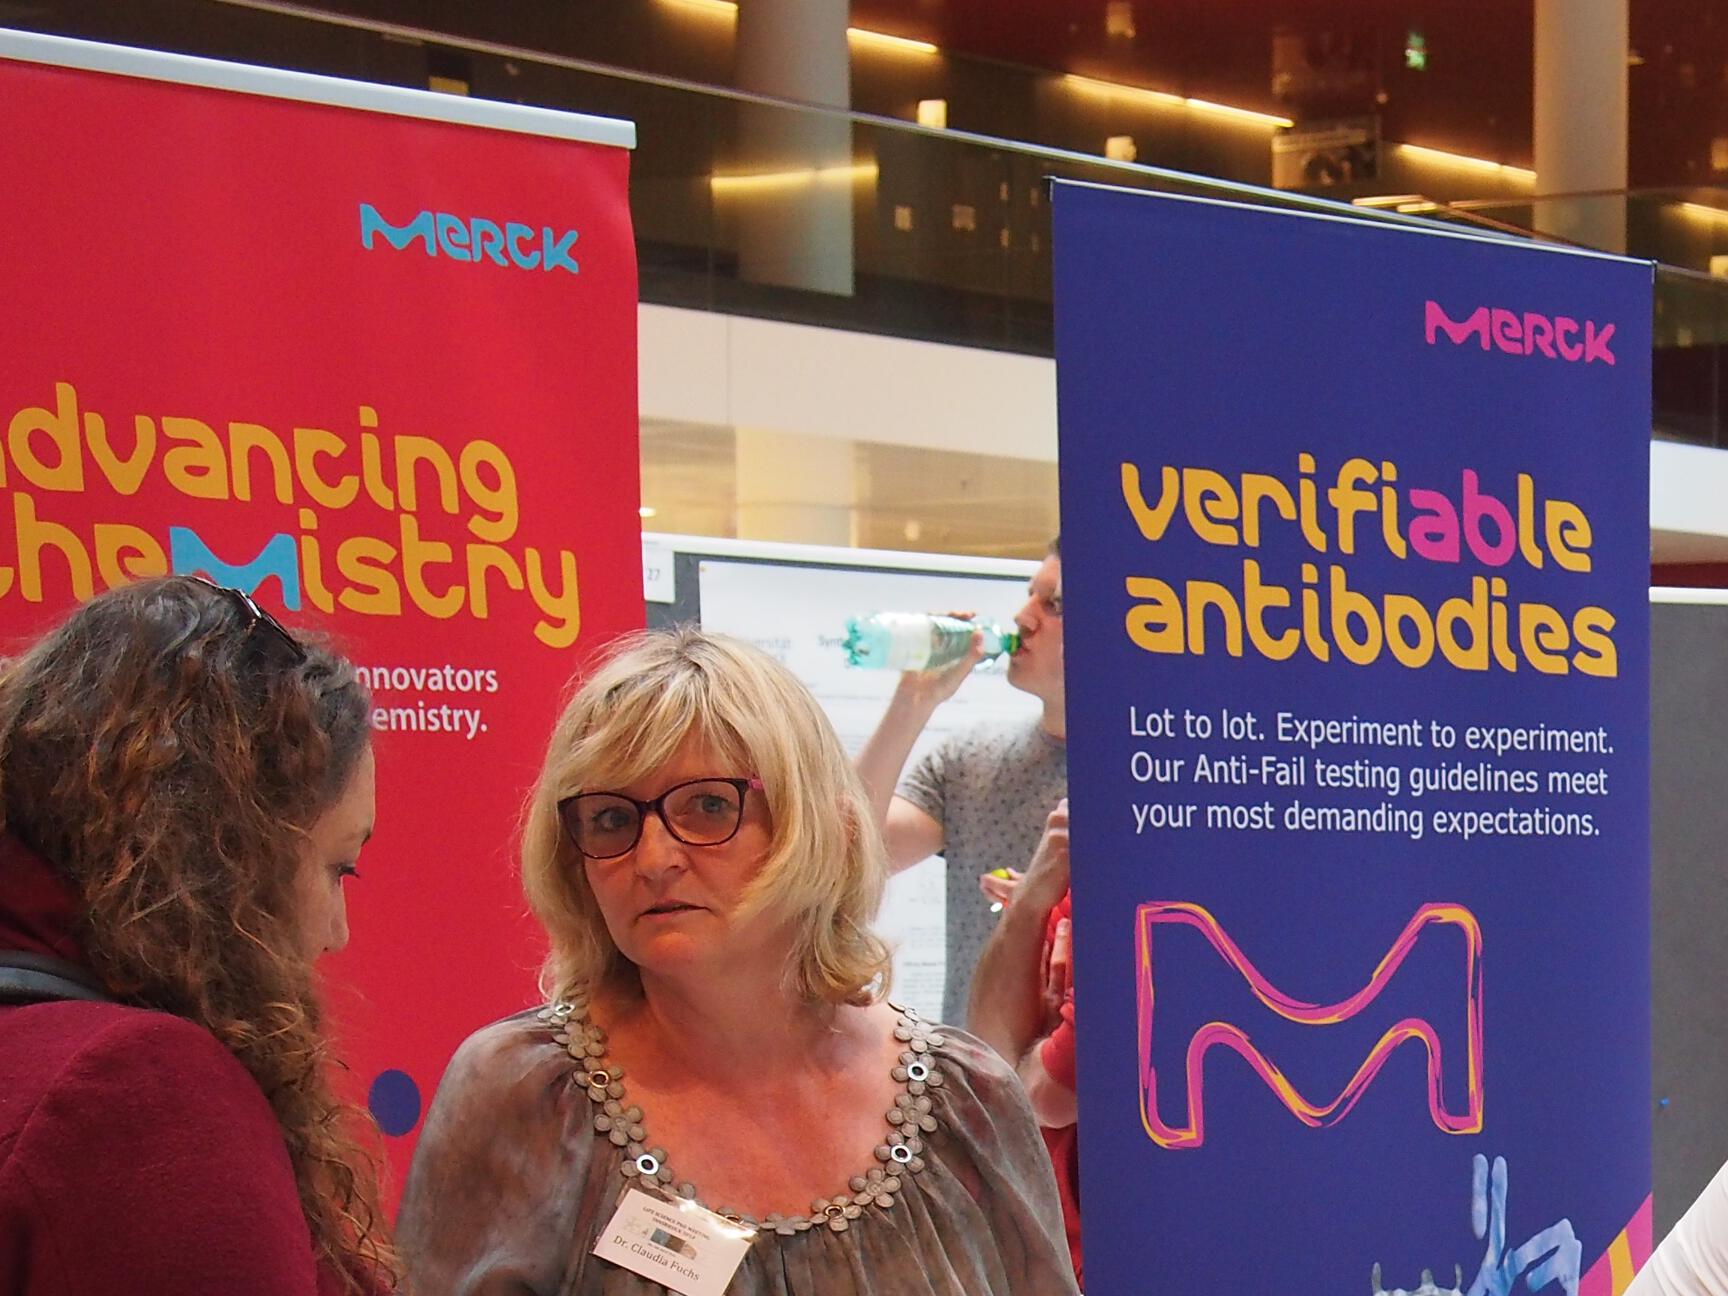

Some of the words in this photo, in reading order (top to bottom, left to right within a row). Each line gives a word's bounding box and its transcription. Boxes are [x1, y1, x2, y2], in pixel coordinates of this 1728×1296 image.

[0, 382, 519, 542] dvancing
[1121, 452, 1593, 573] verifiable
[1126, 559, 1618, 678] antibodies
[355, 664, 499, 692] nnovators
[372, 700, 488, 740] emistry.
[1130, 706, 1175, 737] Lot
[1185, 714, 1212, 739] to
[1222, 708, 1265, 741] lot.
[1277, 712, 1422, 749] Experiment
[1431, 721, 1456, 748] to
[1465, 723, 1614, 757] experiment.
[1131, 752, 1184, 783] Our
[1194, 753, 1305, 787] Anti-Fail
[1315, 758, 1400, 796] testing
[1409, 761, 1539, 797] guidelines
[1548, 768, 1608, 795] meet
[1132, 802, 1197, 833] your
[1207, 801, 1274, 830] most
[1284, 801, 1424, 839] demanding
[1433, 804, 1600, 840] expectations.
[613, 1234, 628, 1252] Dr.
[631, 1242, 669, 1268] Claudia
[670, 1260, 701, 1282] Fuchs
